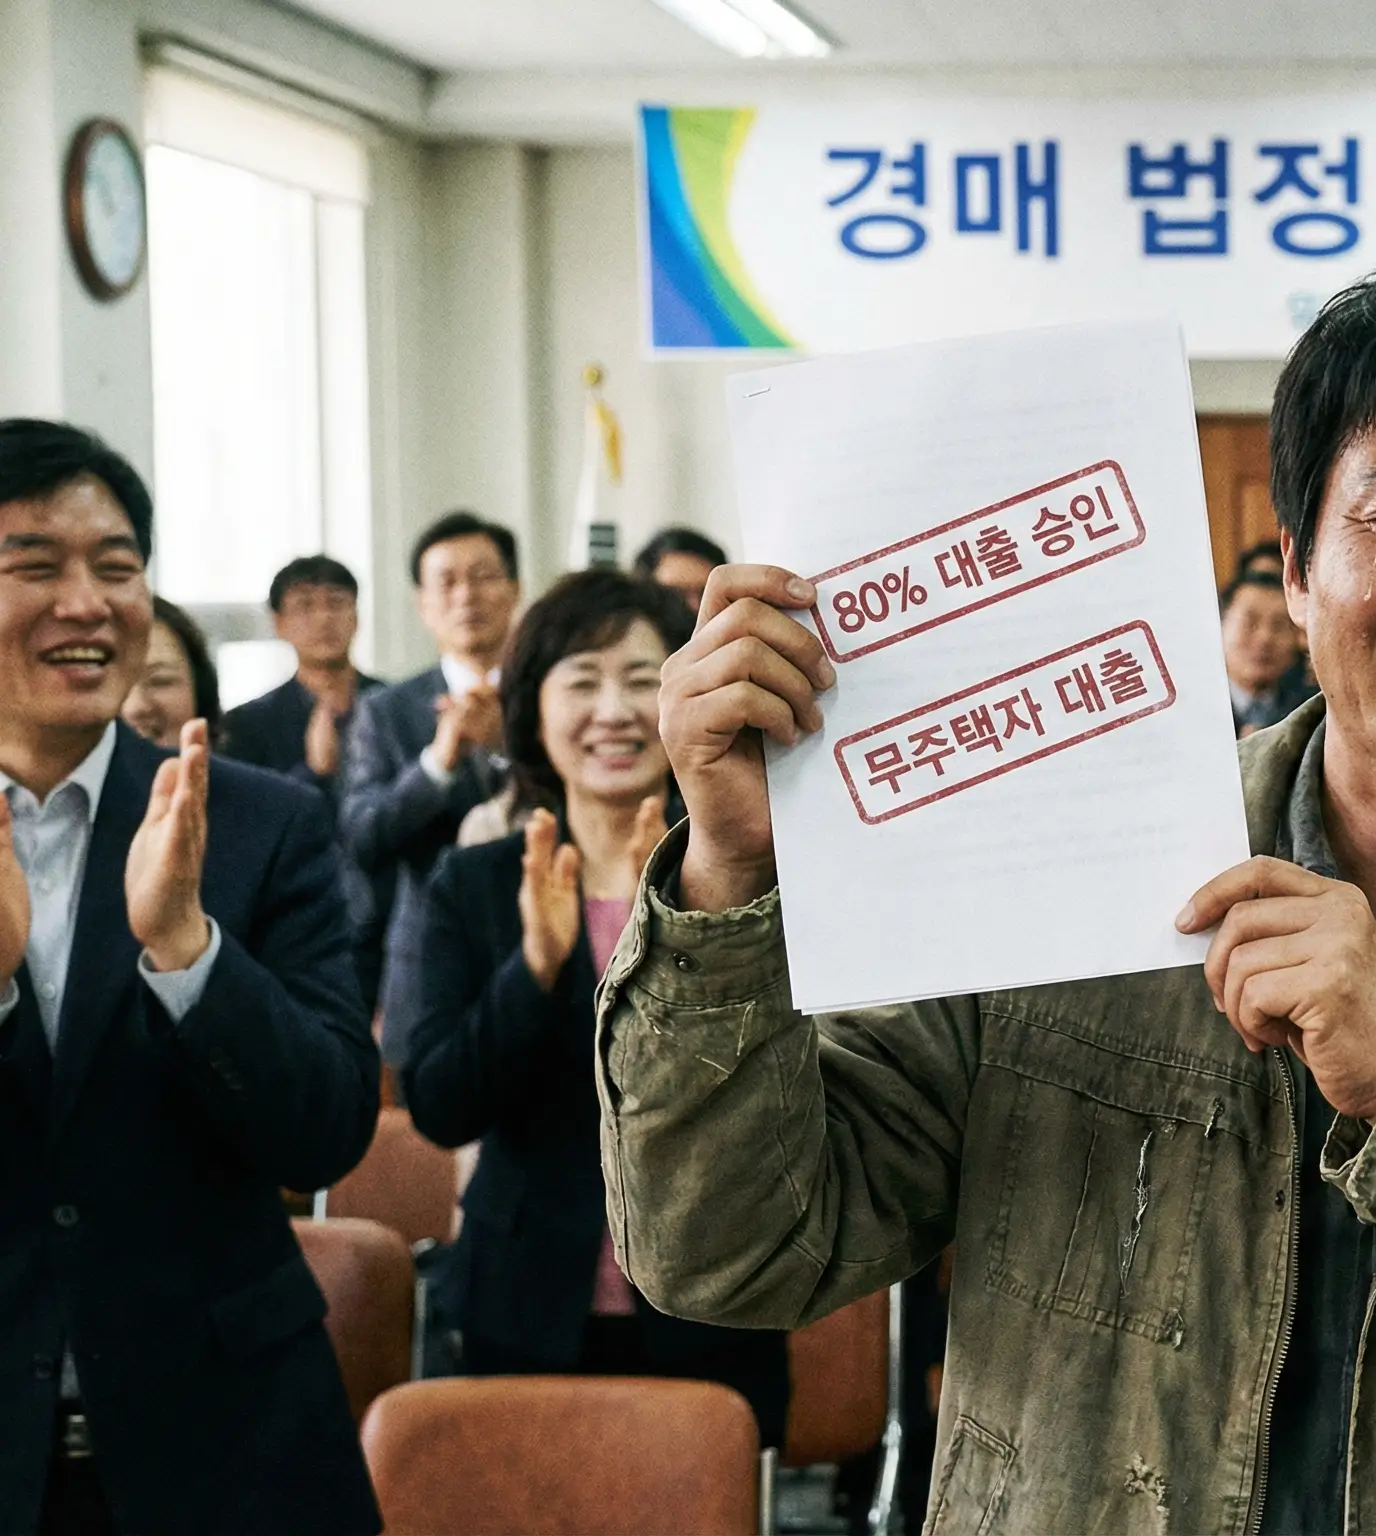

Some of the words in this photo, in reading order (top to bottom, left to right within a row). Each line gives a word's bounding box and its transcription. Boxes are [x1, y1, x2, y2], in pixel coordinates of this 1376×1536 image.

[826, 140, 1060, 261] 경매
[1127, 137, 1362, 259] 법정
[832, 566, 928, 634] 80%
[934, 525, 1023, 589] 대출
[1031, 485, 1120, 557] 승인
[863, 687, 1046, 794] 무주택자
[1054, 648, 1148, 715] 대출
